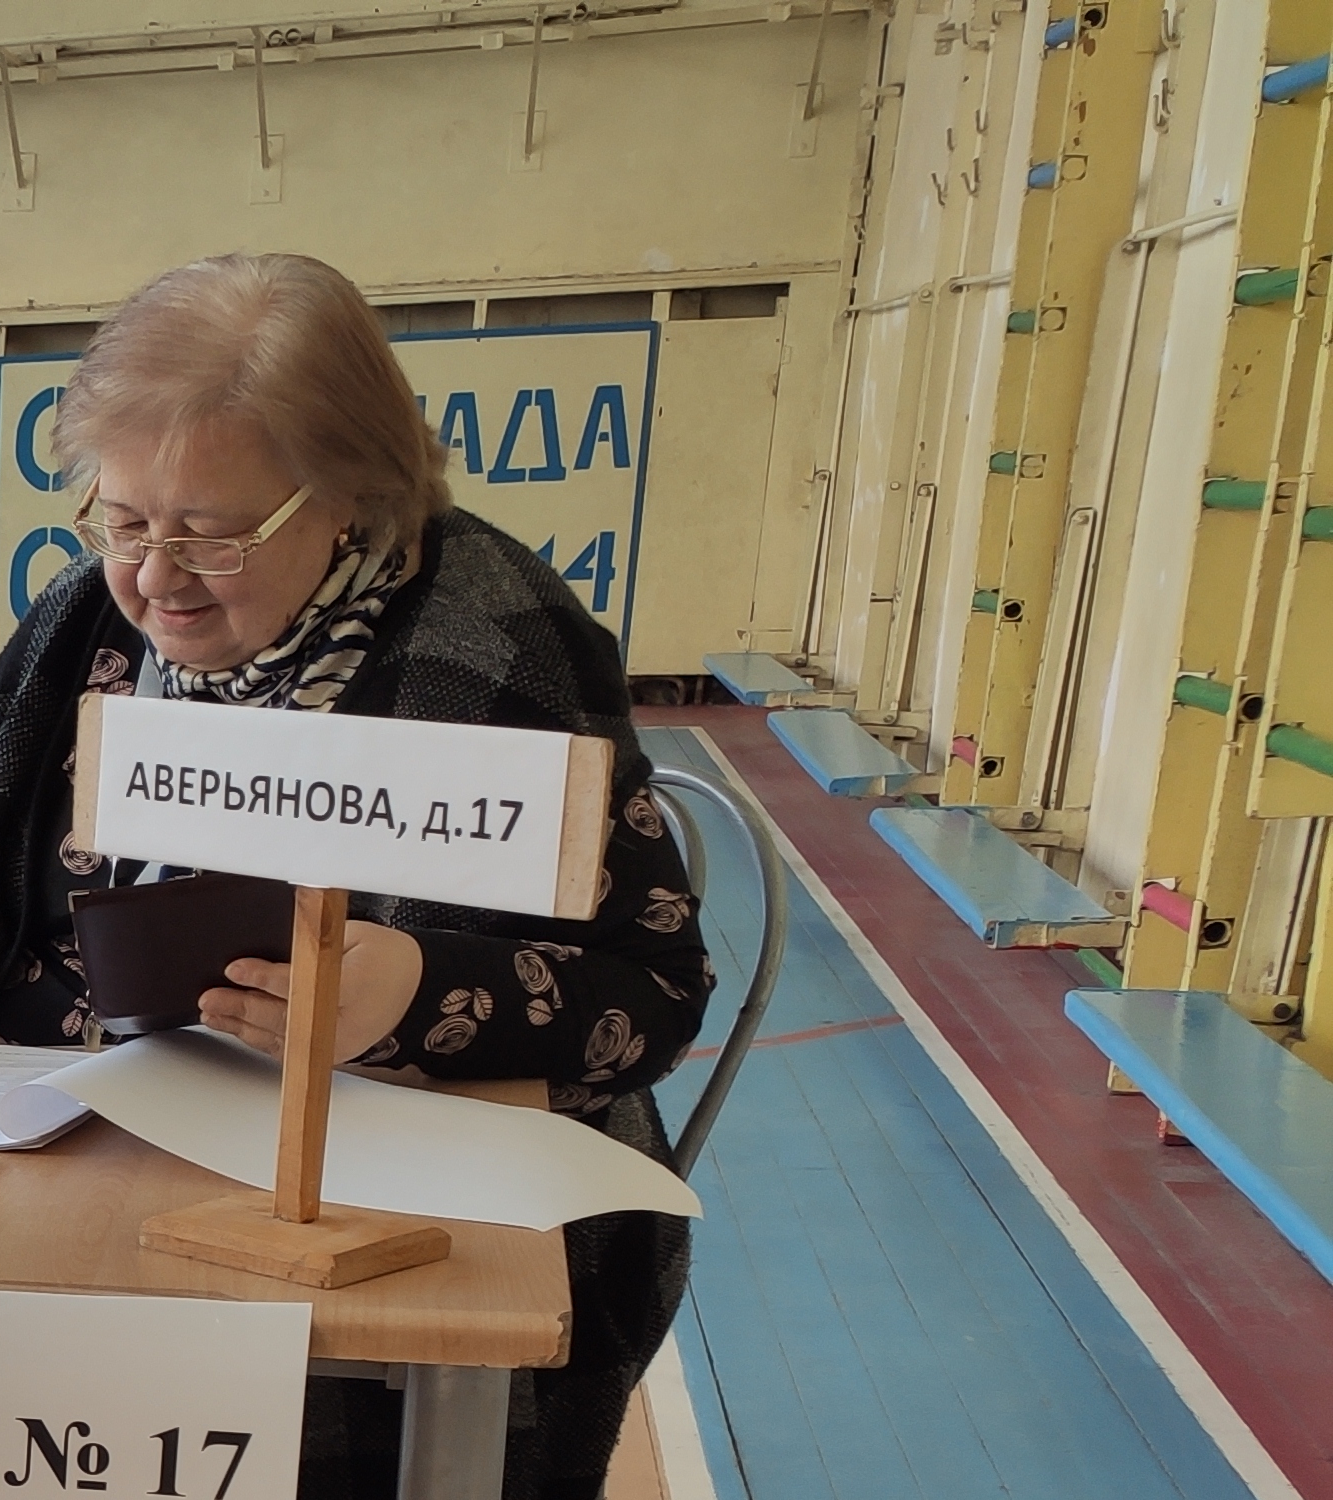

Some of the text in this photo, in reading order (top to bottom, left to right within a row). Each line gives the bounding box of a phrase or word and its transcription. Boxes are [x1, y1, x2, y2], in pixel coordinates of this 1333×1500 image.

[125, 760, 525, 844] АВЕРЬЯНОВА, д.17
[3, 1416, 111, 1492] №
